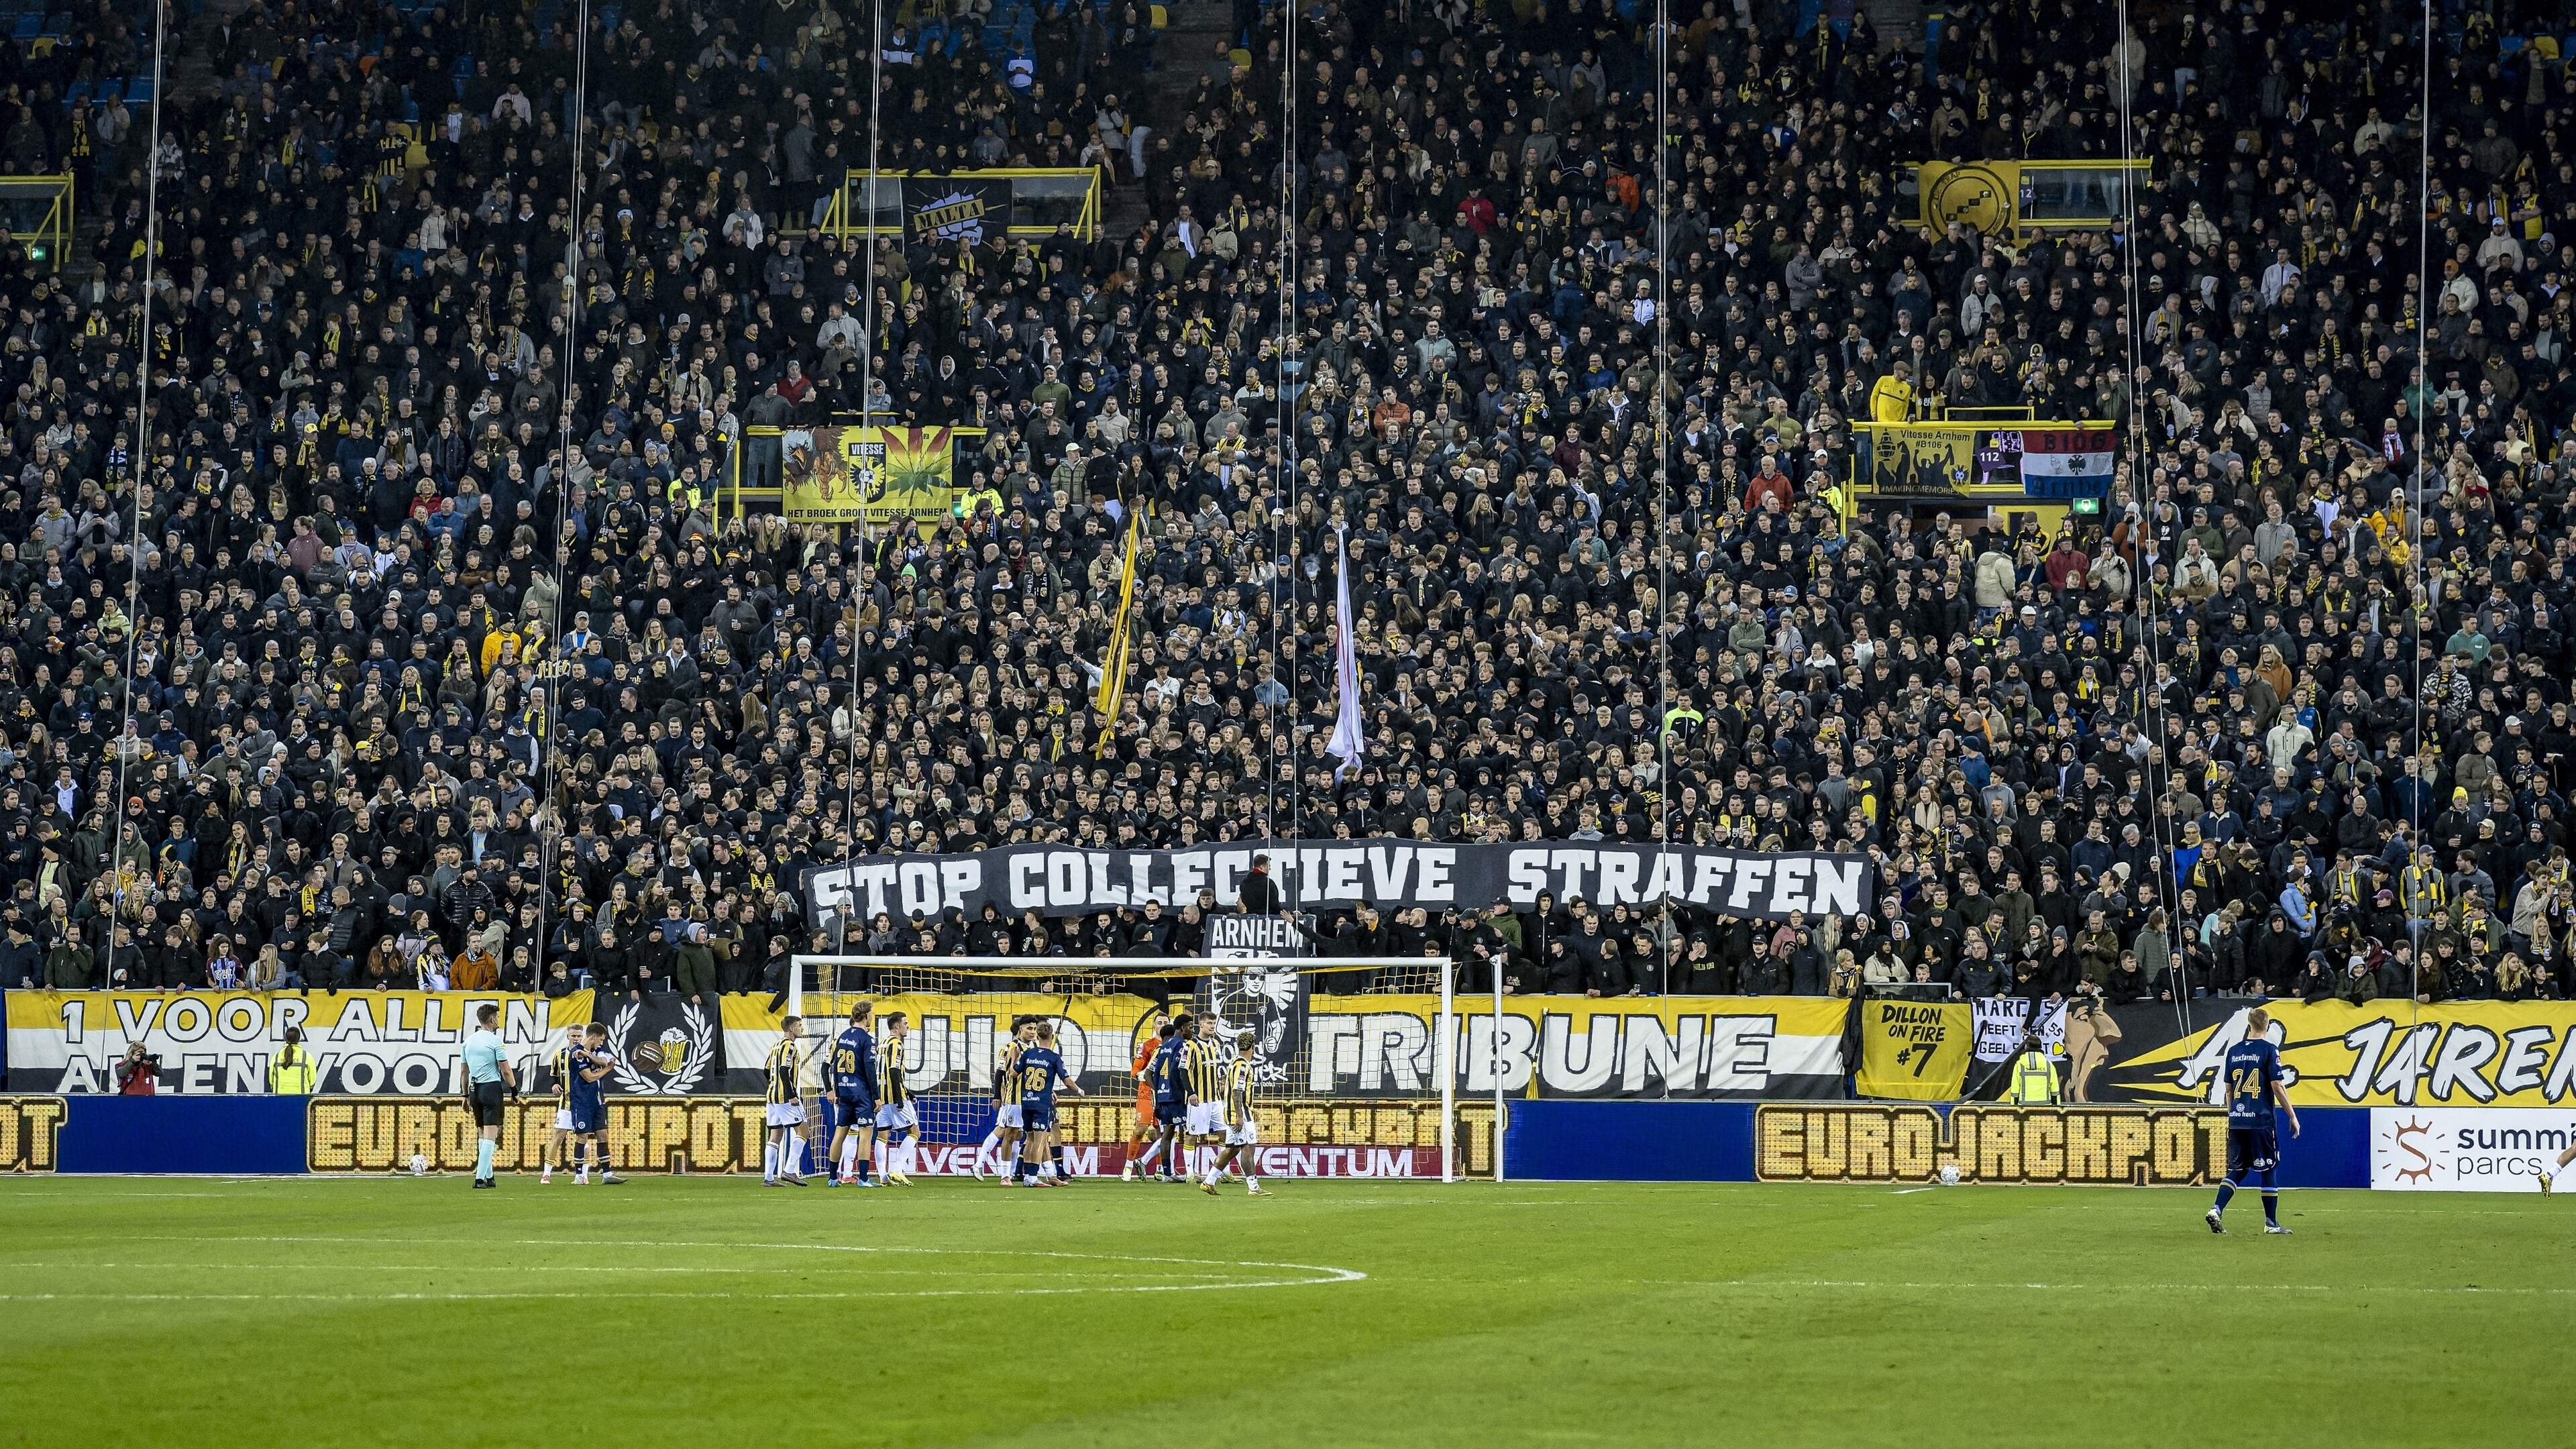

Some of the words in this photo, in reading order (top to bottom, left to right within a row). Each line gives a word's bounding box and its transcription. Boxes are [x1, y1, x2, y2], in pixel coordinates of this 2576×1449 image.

[918, 202, 981, 229] MALTA
[1900, 429, 1933, 439] Vitesse
[1935, 431, 1970, 441] Arnhem
[851, 443, 883, 455] VITESSE
[1980, 452, 2000, 462] 112
[788, 509, 804, 518] HET
[807, 508, 837, 518] BROEK
[870, 508, 906, 517] VITESSE
[909, 508, 947, 517] ARNHEM
[812, 859, 982, 921] STOP
[1009, 847, 1454, 910] COLLECTIEVE
[1507, 849, 1864, 916] STRAFFEN
[1212, 918, 1303, 948] ARNHEM
[1881, 1004, 1942, 1025] DILLON
[1973, 998, 2054, 1018] MARCS
[61, 999, 85, 1044] 1
[113, 997, 309, 1043] VOOR
[327, 997, 551, 1044] ALLEN
[1888, 1024, 1909, 1038] ON
[1909, 1025, 1946, 1042] FIRE
[1308, 1011, 1778, 1093] TRIBUNE
[1979, 1041, 2010, 1055] GEEL
[2231, 1054, 2260, 1063] flexfamily
[837, 1049, 855, 1073] 28
[1160, 1057, 1169, 1080] 4
[1896, 1043, 1938, 1078] #7
[518, 1054, 541, 1095] 1
[1024, 1067, 1047, 1091] 26
[2232, 1068, 2261, 1099] 24
[315, 1105, 768, 1169] EUROJAKPOT
[1762, 1112, 2229, 1180] EUROJACKPOT
[2457, 1155, 2543, 1181] parcs
